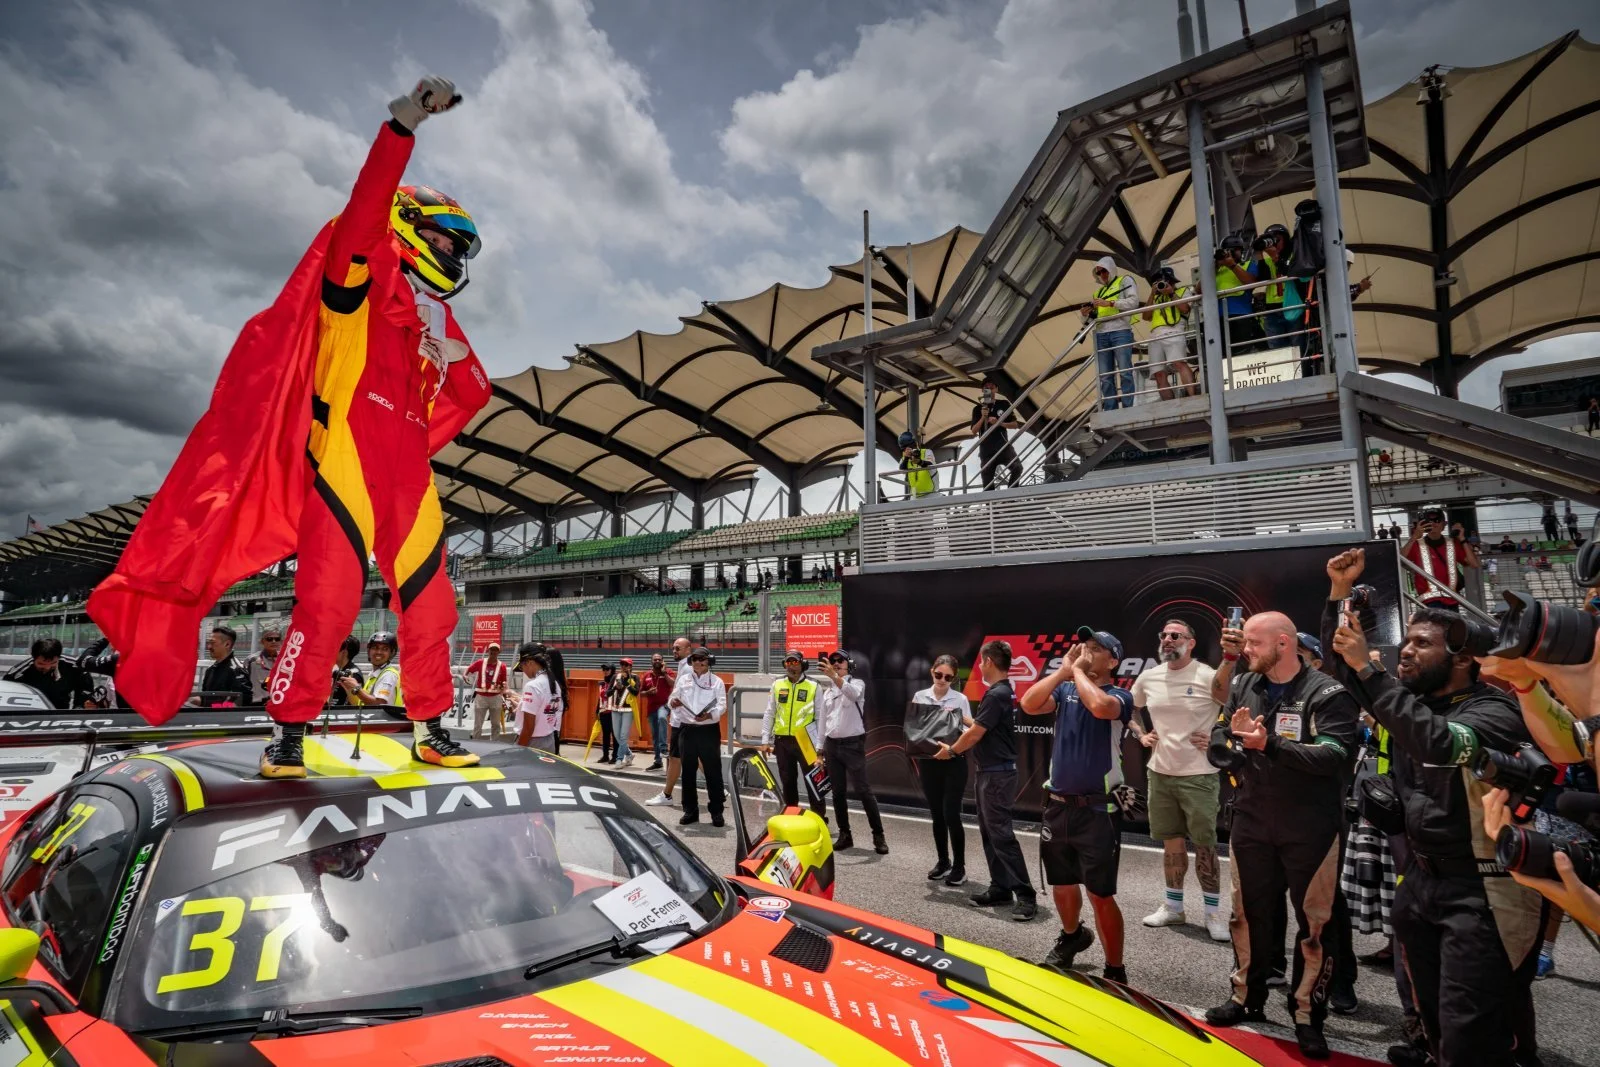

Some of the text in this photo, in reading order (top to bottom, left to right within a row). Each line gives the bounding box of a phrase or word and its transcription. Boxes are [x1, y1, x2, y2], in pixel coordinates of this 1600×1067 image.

[476, 620, 498, 629] NOTICE
[792, 612, 830, 625] NOTICE
[270, 629, 305, 705] sparco
[211, 782, 619, 871] FANATEC
[628, 915, 656, 933] Parc
[650, 899, 681, 919] Ferme
[156, 892, 313, 995] 37
[843, 926, 953, 970] gravity
[909, 1018, 930, 1060] CHERRY
